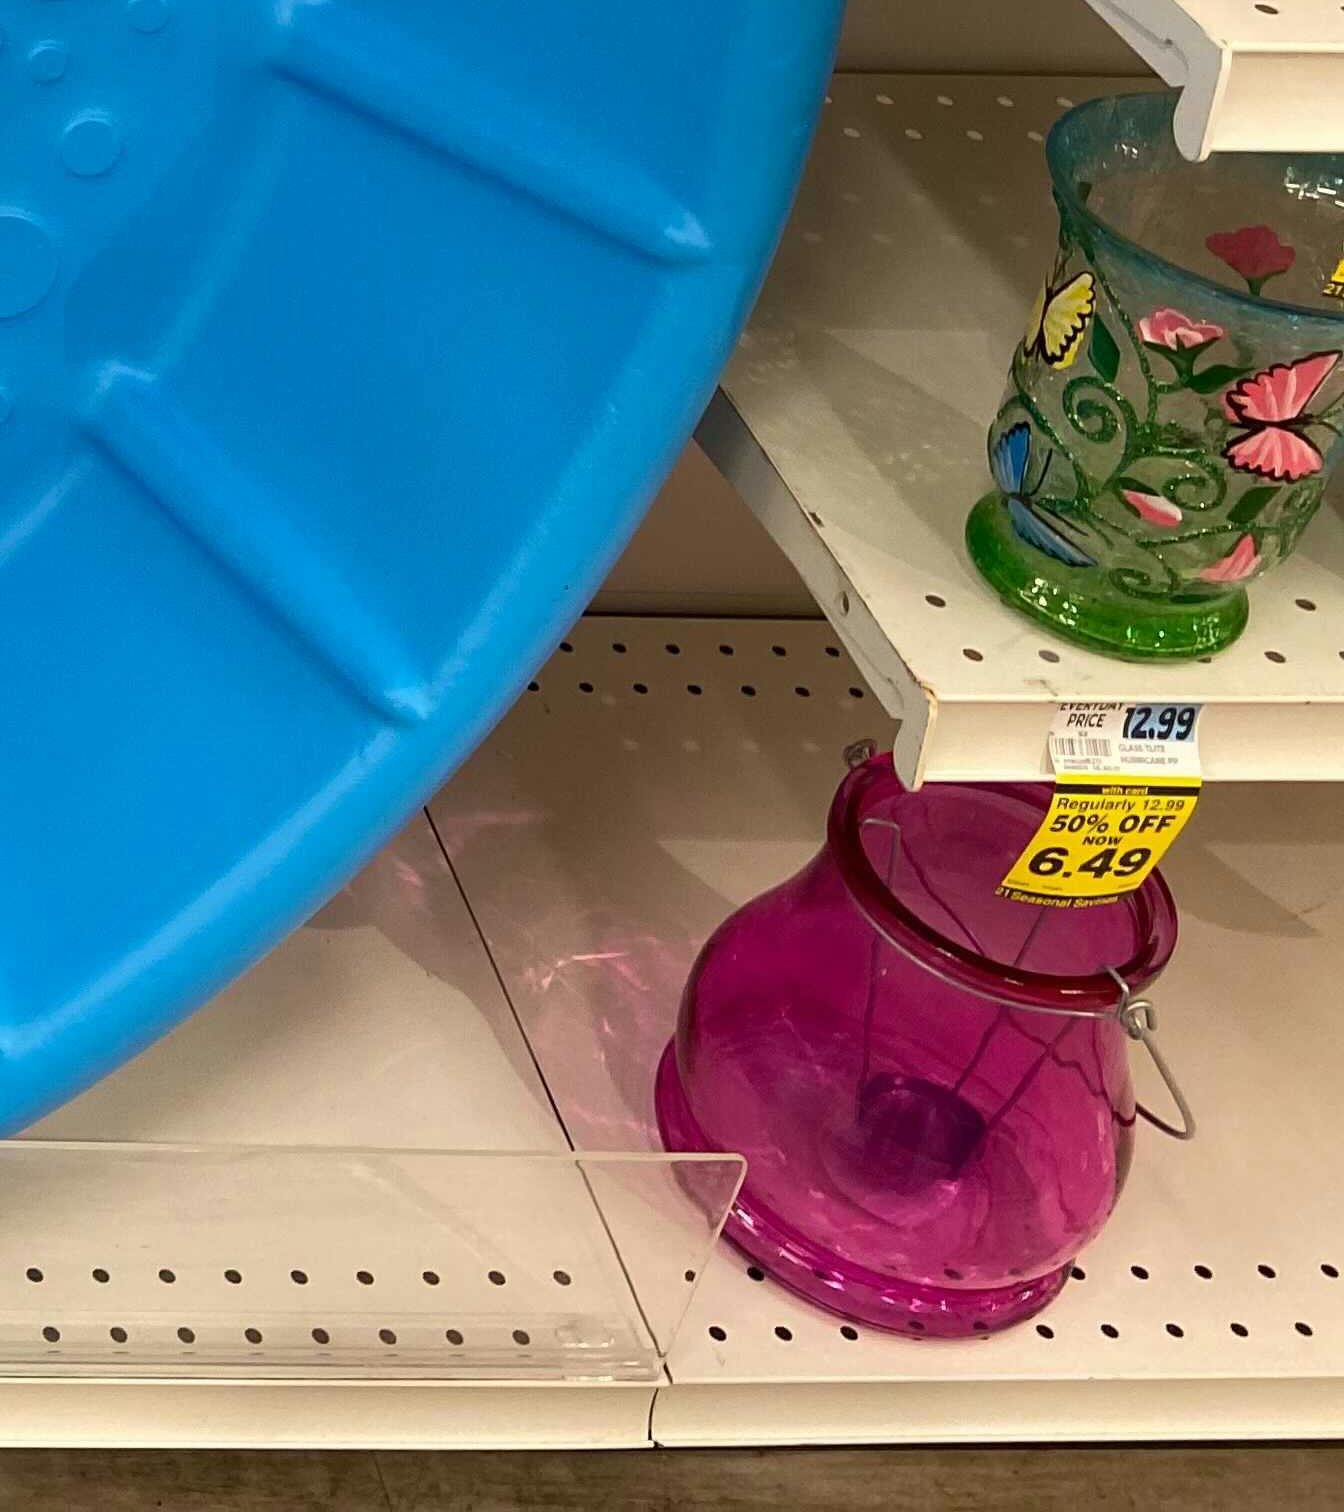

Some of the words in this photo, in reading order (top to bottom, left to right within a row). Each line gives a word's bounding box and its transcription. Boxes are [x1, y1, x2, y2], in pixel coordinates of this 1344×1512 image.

[1066, 714, 1107, 728] PRICE
[1123, 707, 1196, 741] 12.99
[1056, 798, 1136, 813] Regularly
[1143, 799, 1185, 812] 12.99
[1049, 814, 1109, 834] 50%
[1118, 814, 1177, 834] OFF
[1082, 836, 1123, 846] NOW
[1028, 847, 1152, 879] 6.49
[1010, 891, 1072, 909] Seasonal
